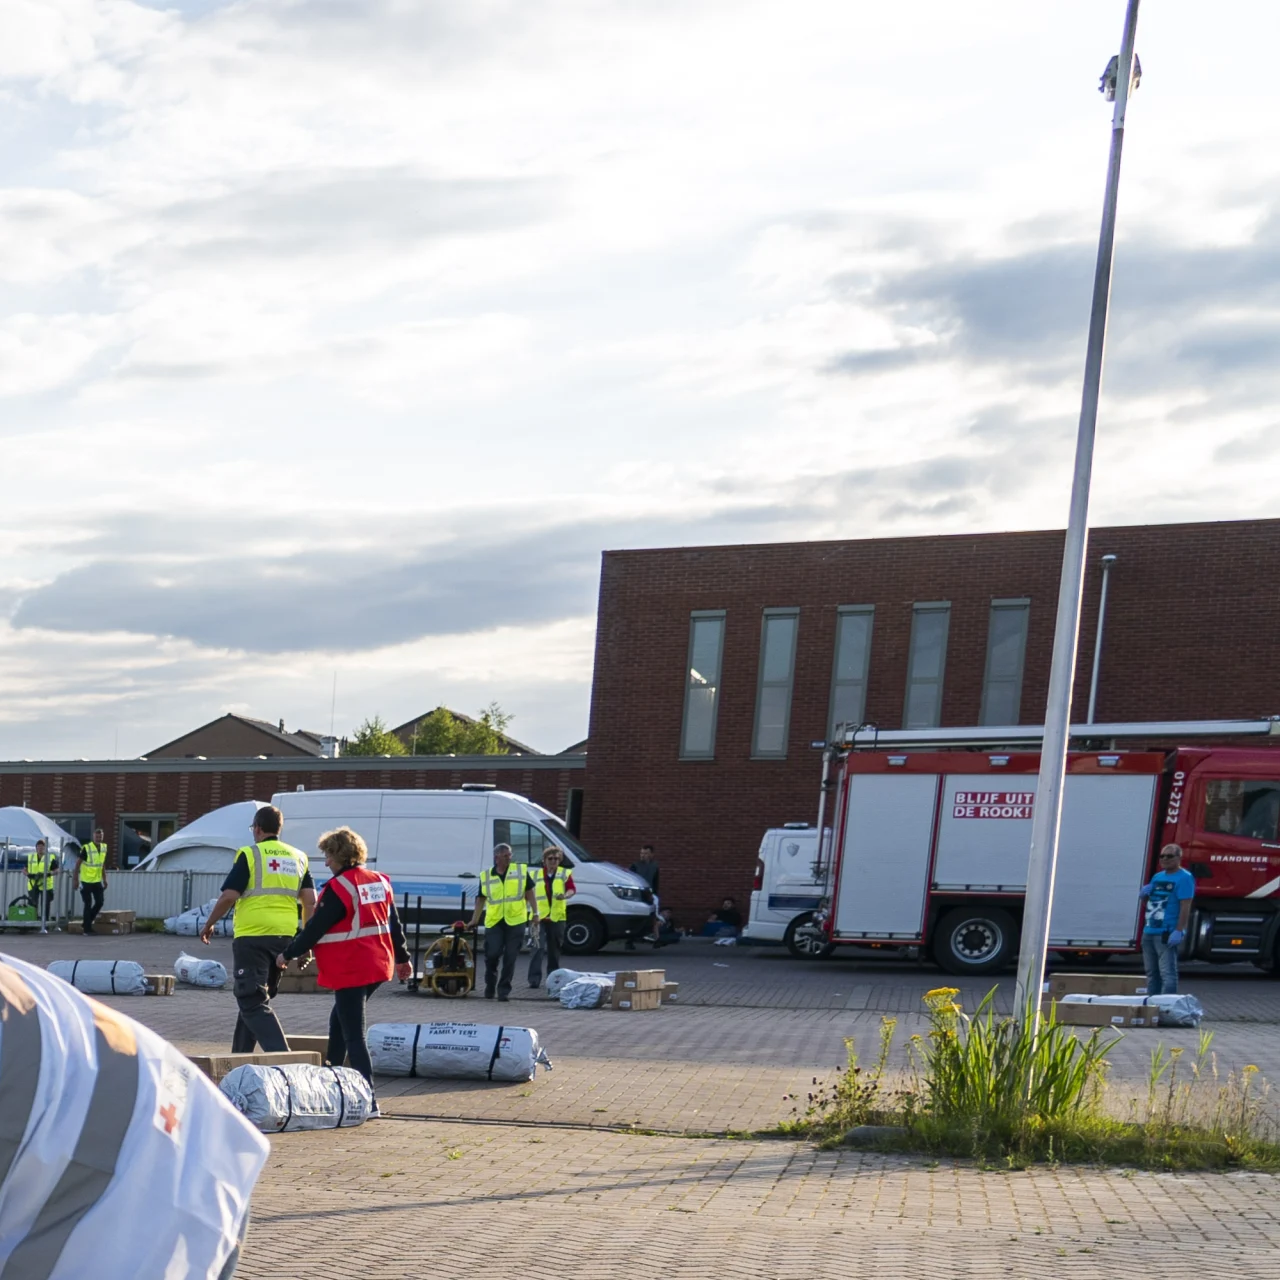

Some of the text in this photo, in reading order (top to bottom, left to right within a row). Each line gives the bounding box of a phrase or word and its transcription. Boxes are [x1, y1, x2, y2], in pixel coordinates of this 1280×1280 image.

[956, 793, 1033, 804] BLIJF UIT
[1166, 771, 1185, 824] 01-2732
[954, 806, 1030, 818] DE ROOK!
[1210, 855, 1268, 863] BRANDWEER
